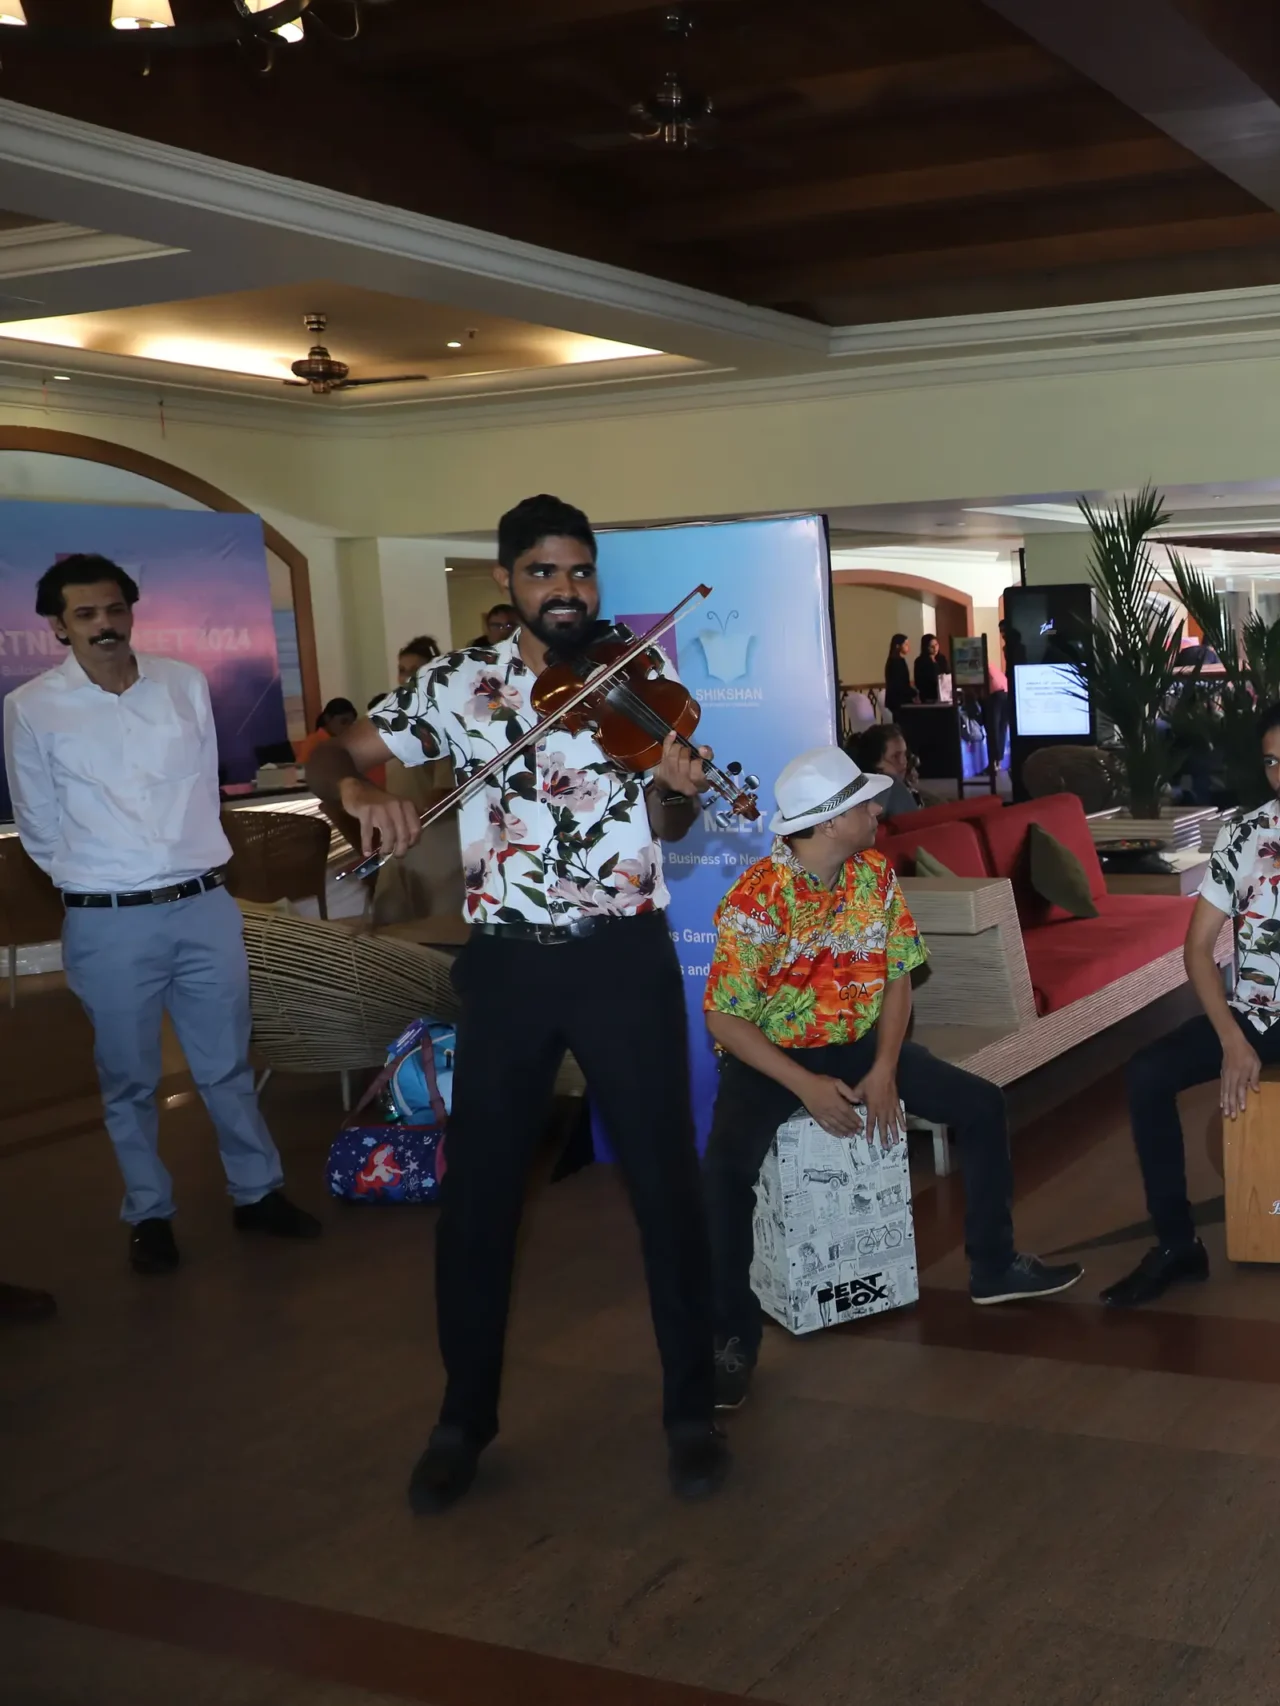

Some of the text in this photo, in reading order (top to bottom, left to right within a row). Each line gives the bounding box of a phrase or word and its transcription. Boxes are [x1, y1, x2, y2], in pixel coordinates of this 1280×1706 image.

[695, 688, 762, 701] SHIKSHAN
[669, 852, 720, 865] Business
[722, 853, 737, 865] To
[688, 962, 711, 976] and
[839, 982, 870, 1001] GOA
[817, 1272, 883, 1304] BEAT
[835, 1284, 889, 1313] BOX
